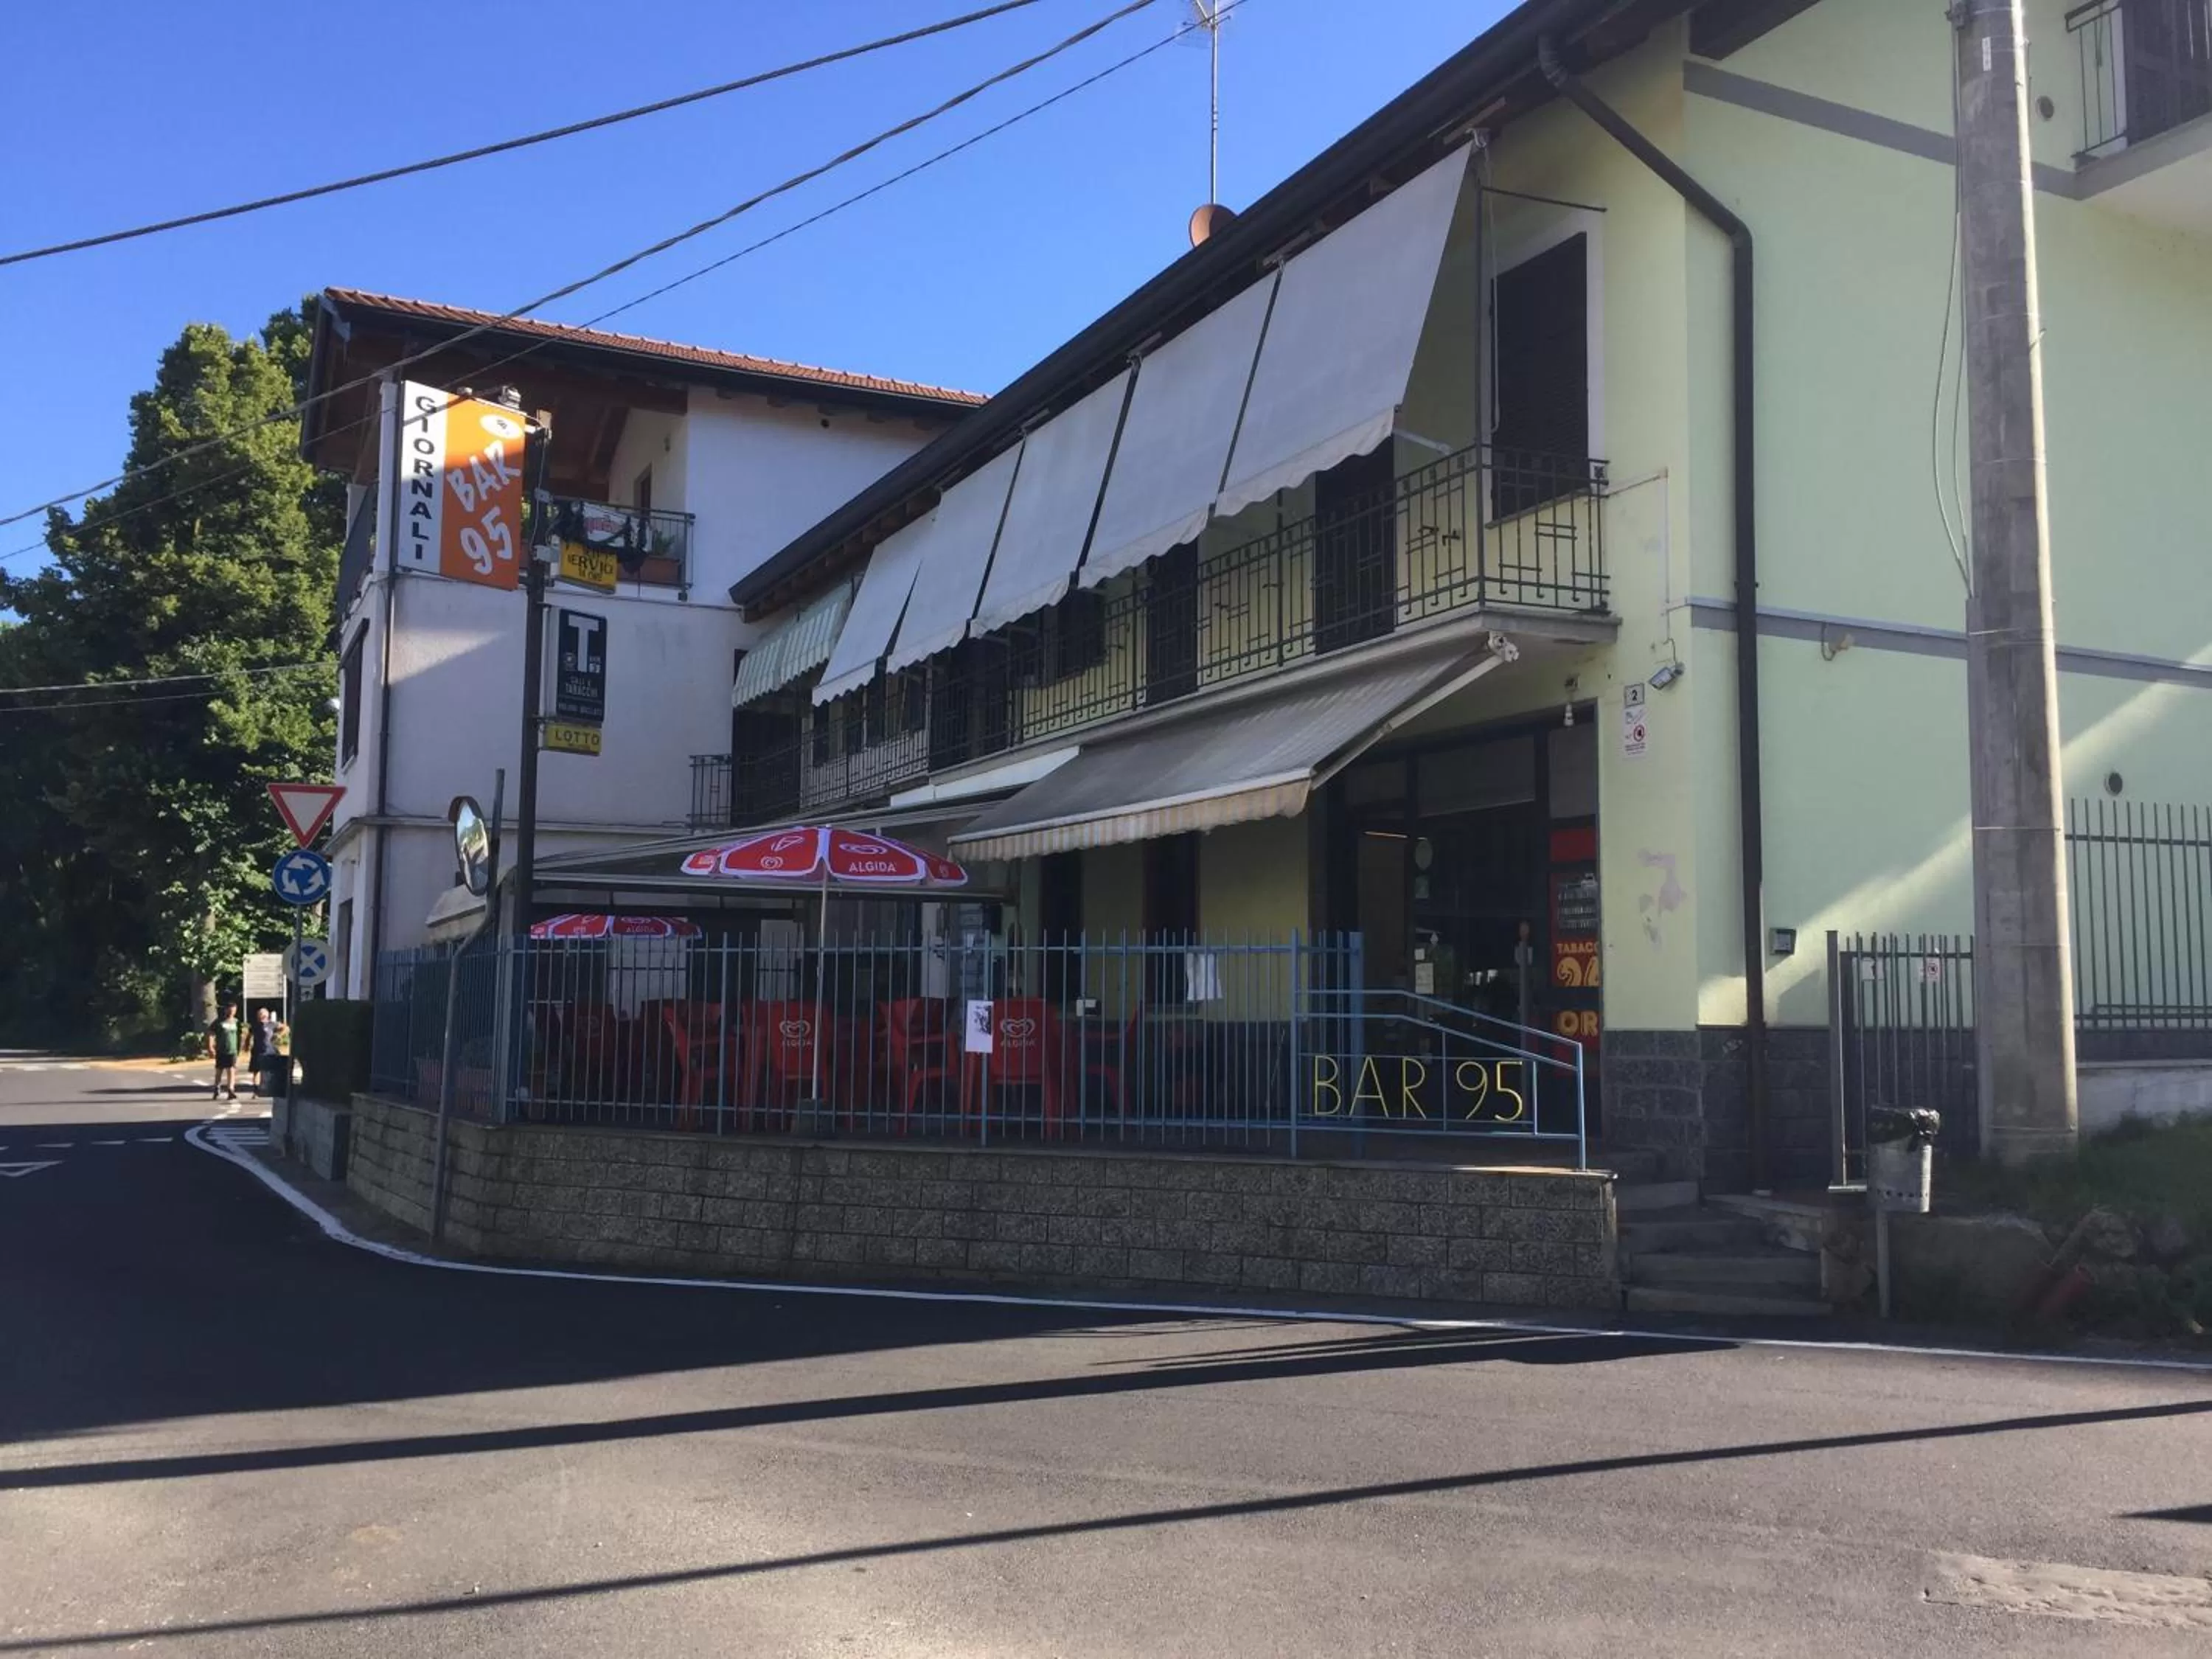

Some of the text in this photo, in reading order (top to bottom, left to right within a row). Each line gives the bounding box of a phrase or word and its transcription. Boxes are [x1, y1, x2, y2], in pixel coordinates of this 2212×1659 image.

[409, 395, 436, 560] GIORNALI
[447, 439, 521, 512] BAR
[460, 505, 512, 574] 95
[568, 613, 599, 673] T
[1632, 689, 1638, 700] 2
[554, 728, 599, 746] LOTTO
[849, 859, 897, 874] ALGIDA
[1313, 1054, 1524, 1121] BAR 95
